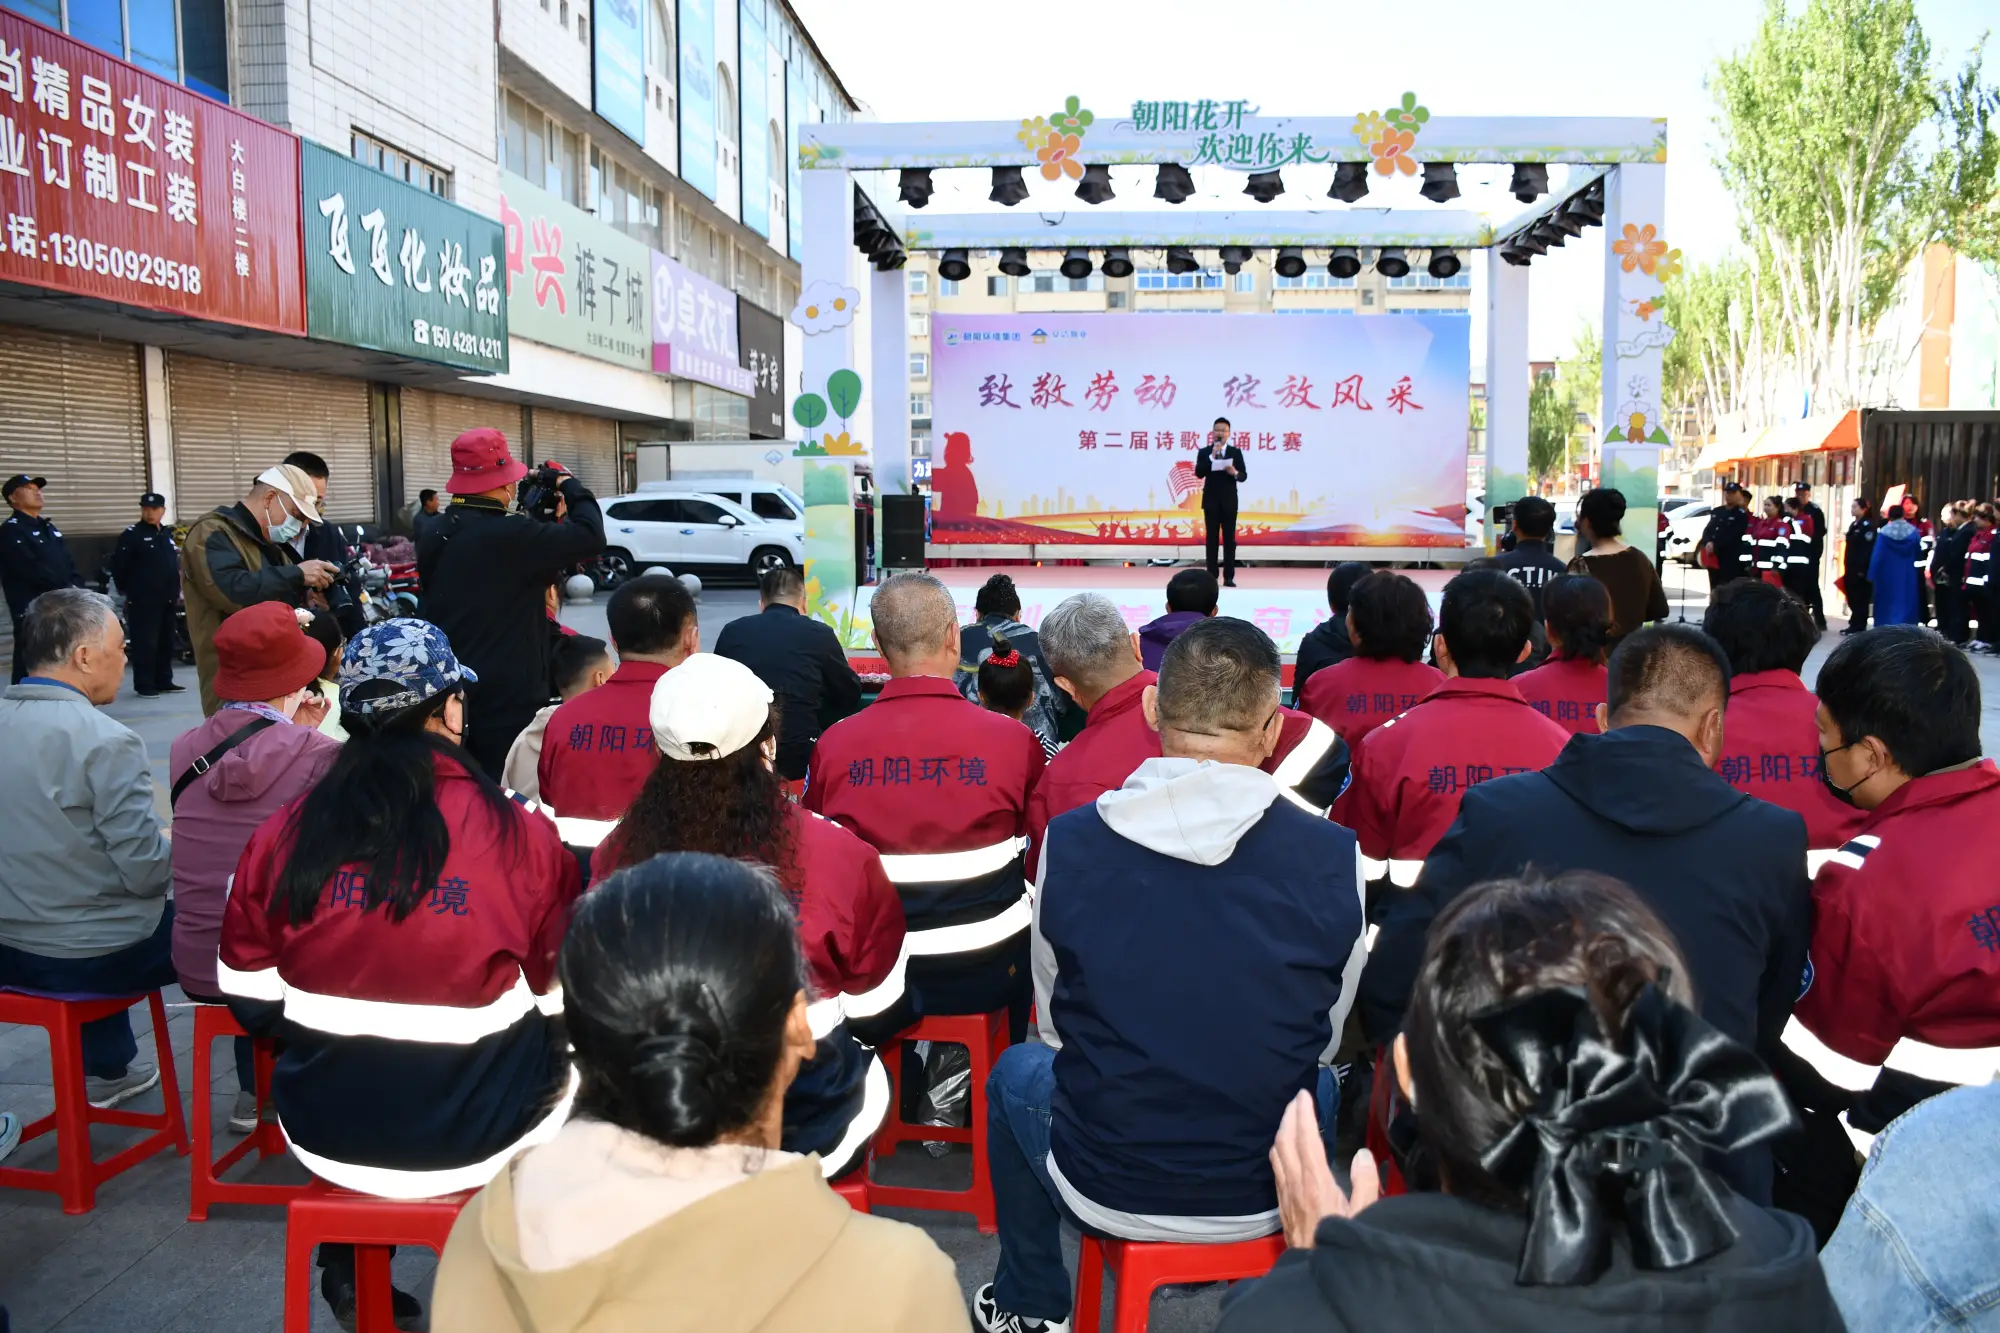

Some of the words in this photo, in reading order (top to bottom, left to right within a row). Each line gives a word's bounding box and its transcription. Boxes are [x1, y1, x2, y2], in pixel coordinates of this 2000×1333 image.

[1130, 98, 1258, 131] 朝阳花开
[1195, 131, 1330, 167] 欢迎你来
[230, 138, 250, 278] 大白楼二楼
[0, 212, 202, 296] 话:13050929518
[318, 191, 500, 316] 飞飞化妆品
[431, 324, 450, 349] 150
[452, 331, 478, 355] 4281
[478, 338, 502, 359] 4211
[977, 369, 1178, 412] 致敬劳动
[1222, 372, 1425, 415] 绽放风采
[847, 756, 988, 788] 朝阳环境
